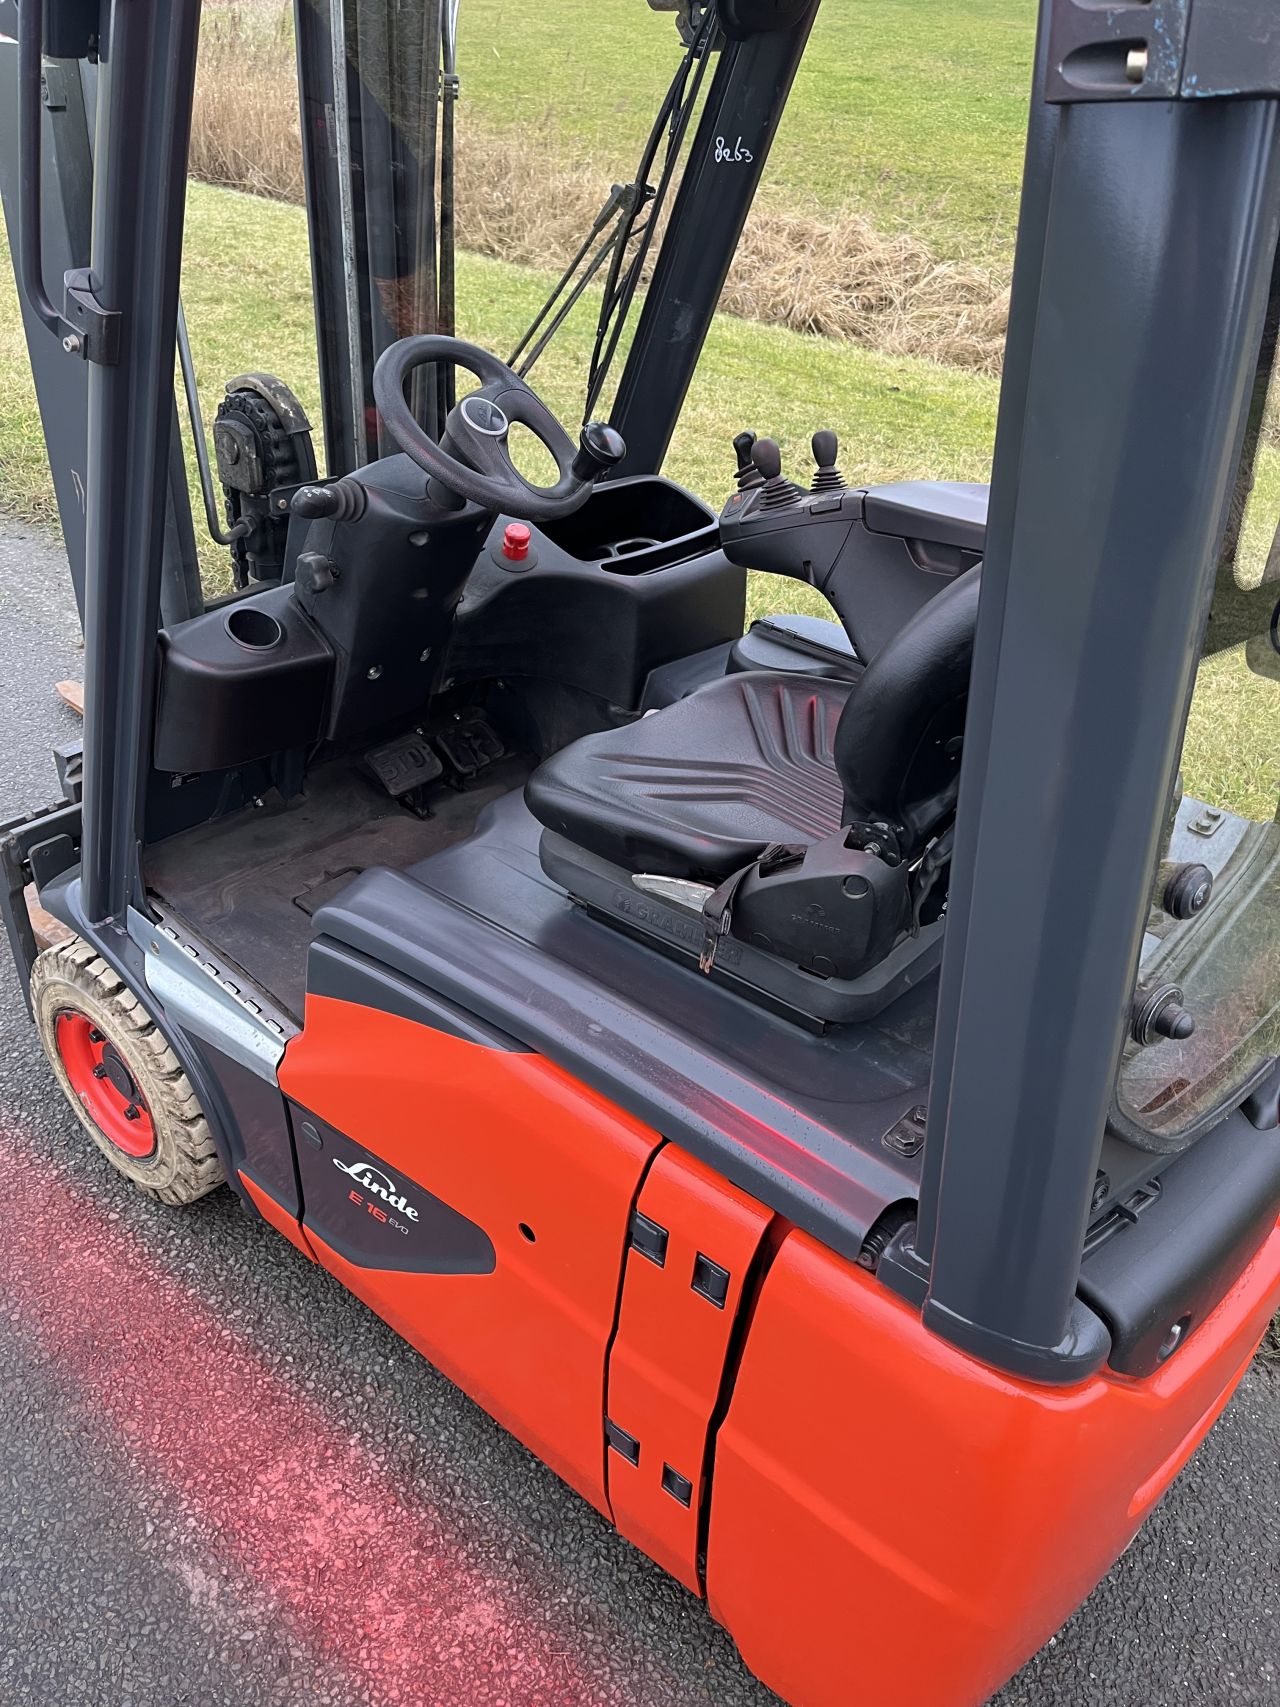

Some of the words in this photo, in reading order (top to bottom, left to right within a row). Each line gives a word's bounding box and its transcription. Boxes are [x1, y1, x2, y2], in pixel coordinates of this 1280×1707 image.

[332, 1158, 419, 1222] Linde
[348, 1190, 364, 1206] E
[367, 1202, 388, 1223] 16
[388, 1217, 409, 1235] EVO
